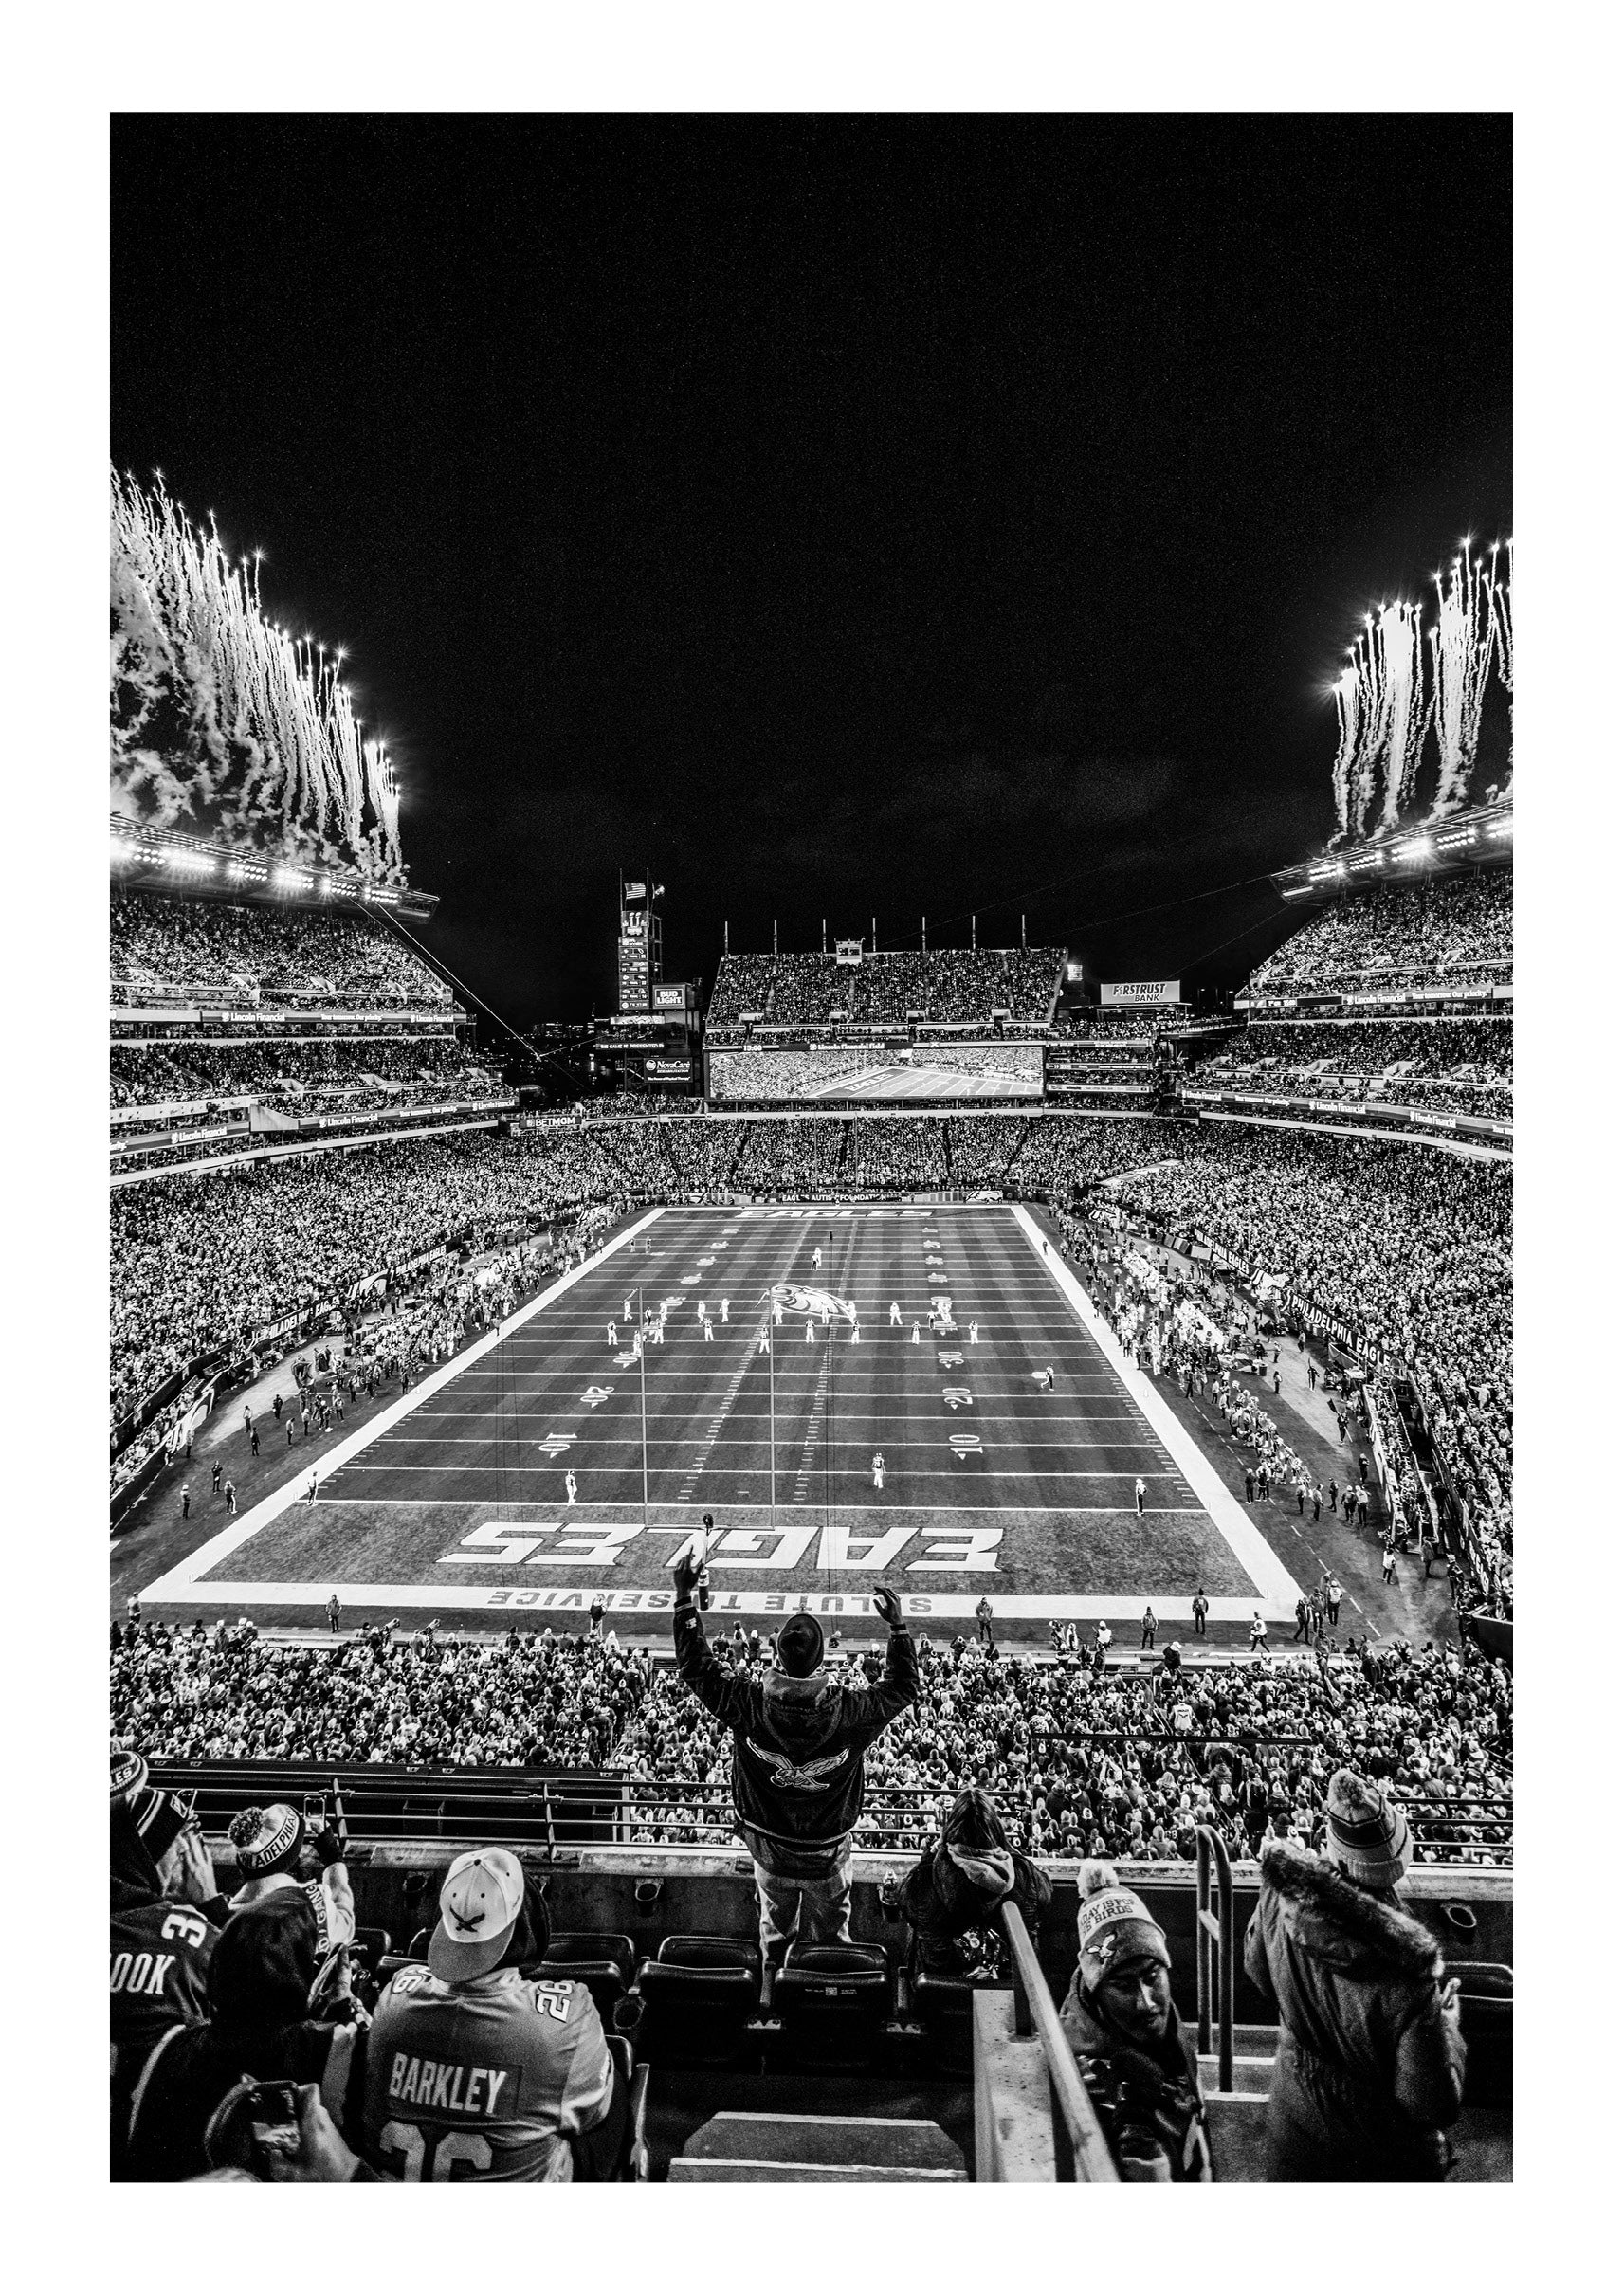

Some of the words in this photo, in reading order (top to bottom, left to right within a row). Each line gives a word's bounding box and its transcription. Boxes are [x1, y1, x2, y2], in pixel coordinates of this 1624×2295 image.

[1354, 995, 1376, 1004] Lincoln
[1377, 993, 1406, 1003] Financial
[230, 1012, 256, 1022] Lincoln
[256, 1012, 285, 1022] Financial
[656, 1060, 690, 1069] NovaCare
[1316, 1102, 1338, 1112] Lincoln
[1338, 1102, 1366, 1114] Financial
[327, 1116, 350, 1126] Lincoln
[351, 1113, 378, 1124] Financial
[535, 1117, 575, 1127] BETMGM
[1415, 1112, 1432, 1124] Lincoln
[1432, 1115, 1456, 1128] Financial
[178, 1130, 201, 1142] Lincoln
[201, 1126, 228, 1138] Financial
[735, 1210, 935, 1219] EAGLES
[1292, 1294, 1353, 1348] PHILADELPHIA
[1356, 1336, 1391, 1367] EAGLE
[938, 1351, 965, 1365] 30
[580, 1385, 615, 1403] 20
[942, 1387, 974, 1405] 20
[538, 1432, 578, 1452] 10
[949, 1433, 984, 1454] 10
[435, 1521, 1005, 1573] EAGLES
[764, 1594, 933, 1613] SLUTE
[1102, 1899, 1114, 1909] IS
[1094, 1905, 1134, 1924] BIRDS
[110, 1952, 176, 1994] OOK
[535, 1979, 573, 2023] 26
[389, 2050, 508, 2115] BARKLEY
